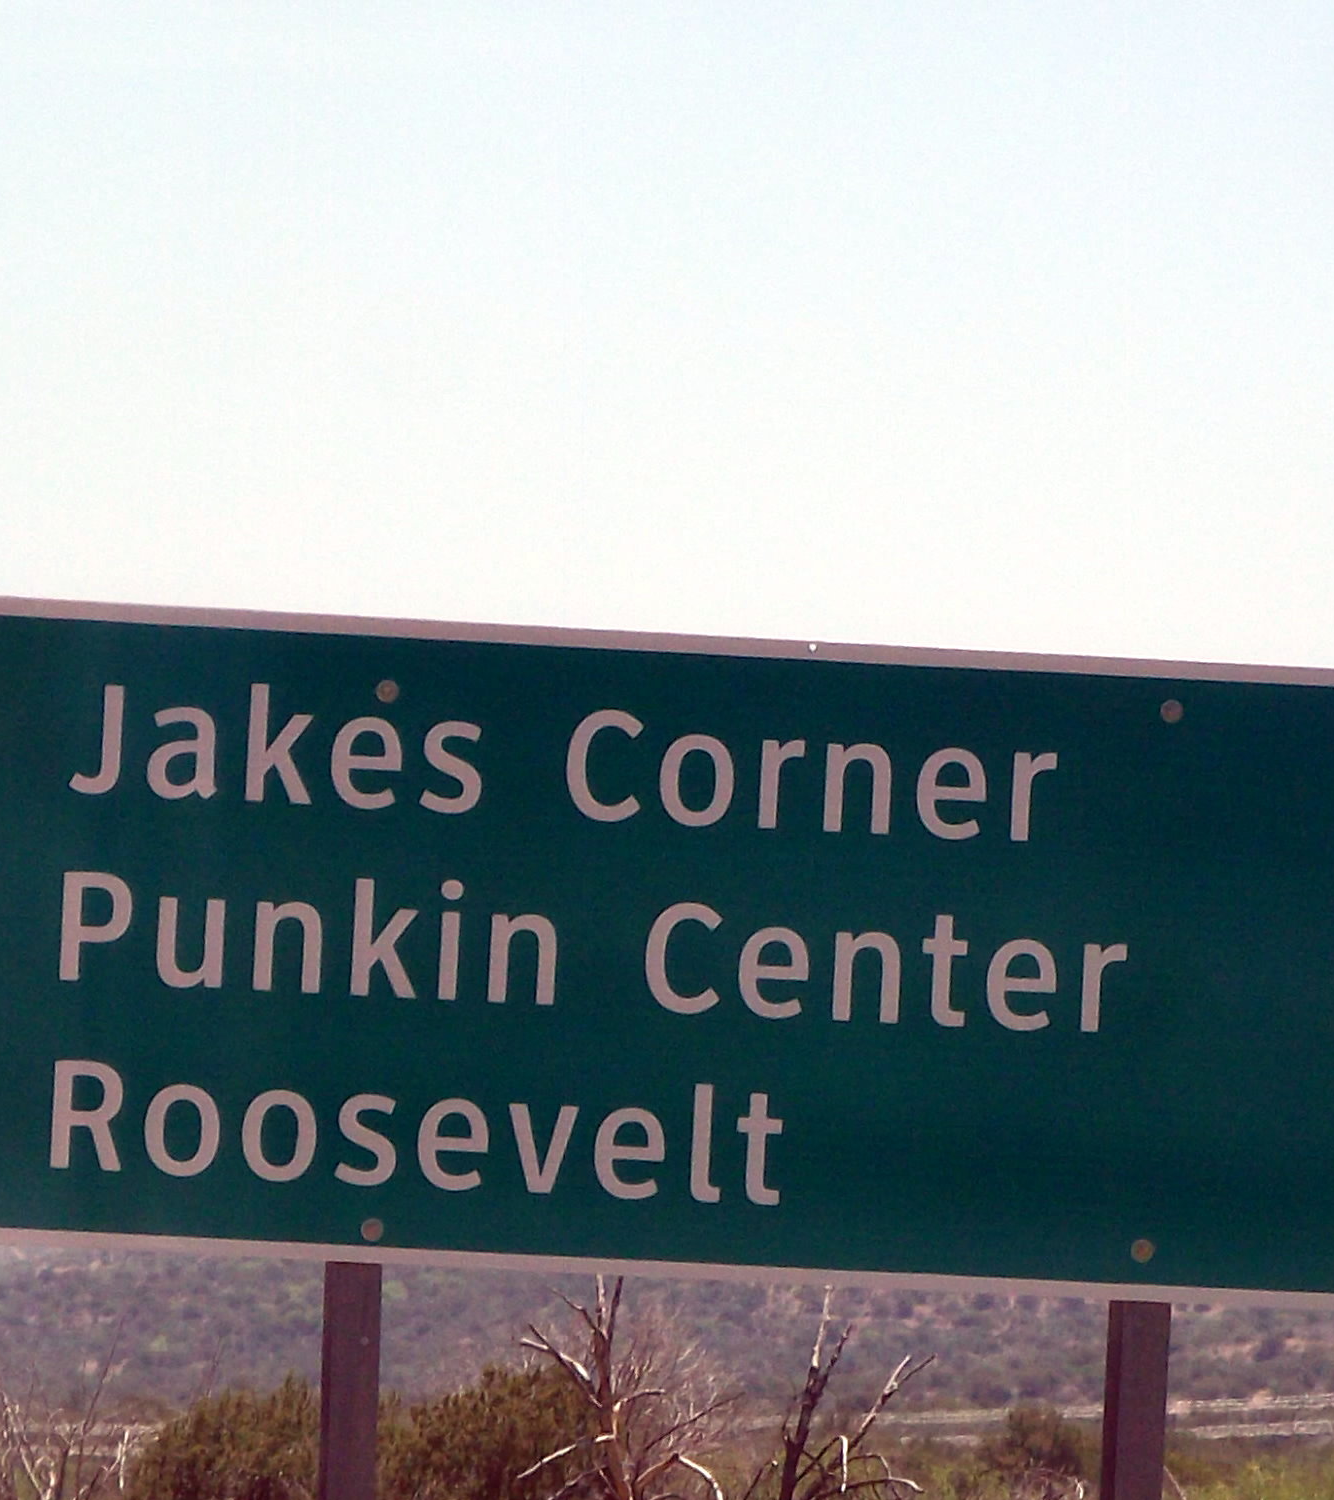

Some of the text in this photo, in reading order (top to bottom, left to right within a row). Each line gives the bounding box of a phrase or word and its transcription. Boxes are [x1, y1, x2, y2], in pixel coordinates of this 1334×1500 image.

[69, 684, 482, 814] Jakes
[566, 709, 1058, 841] Corner
[59, 871, 557, 1005] Punkin
[645, 902, 1128, 1032] Center
[50, 1059, 783, 1206] Roosevelt
